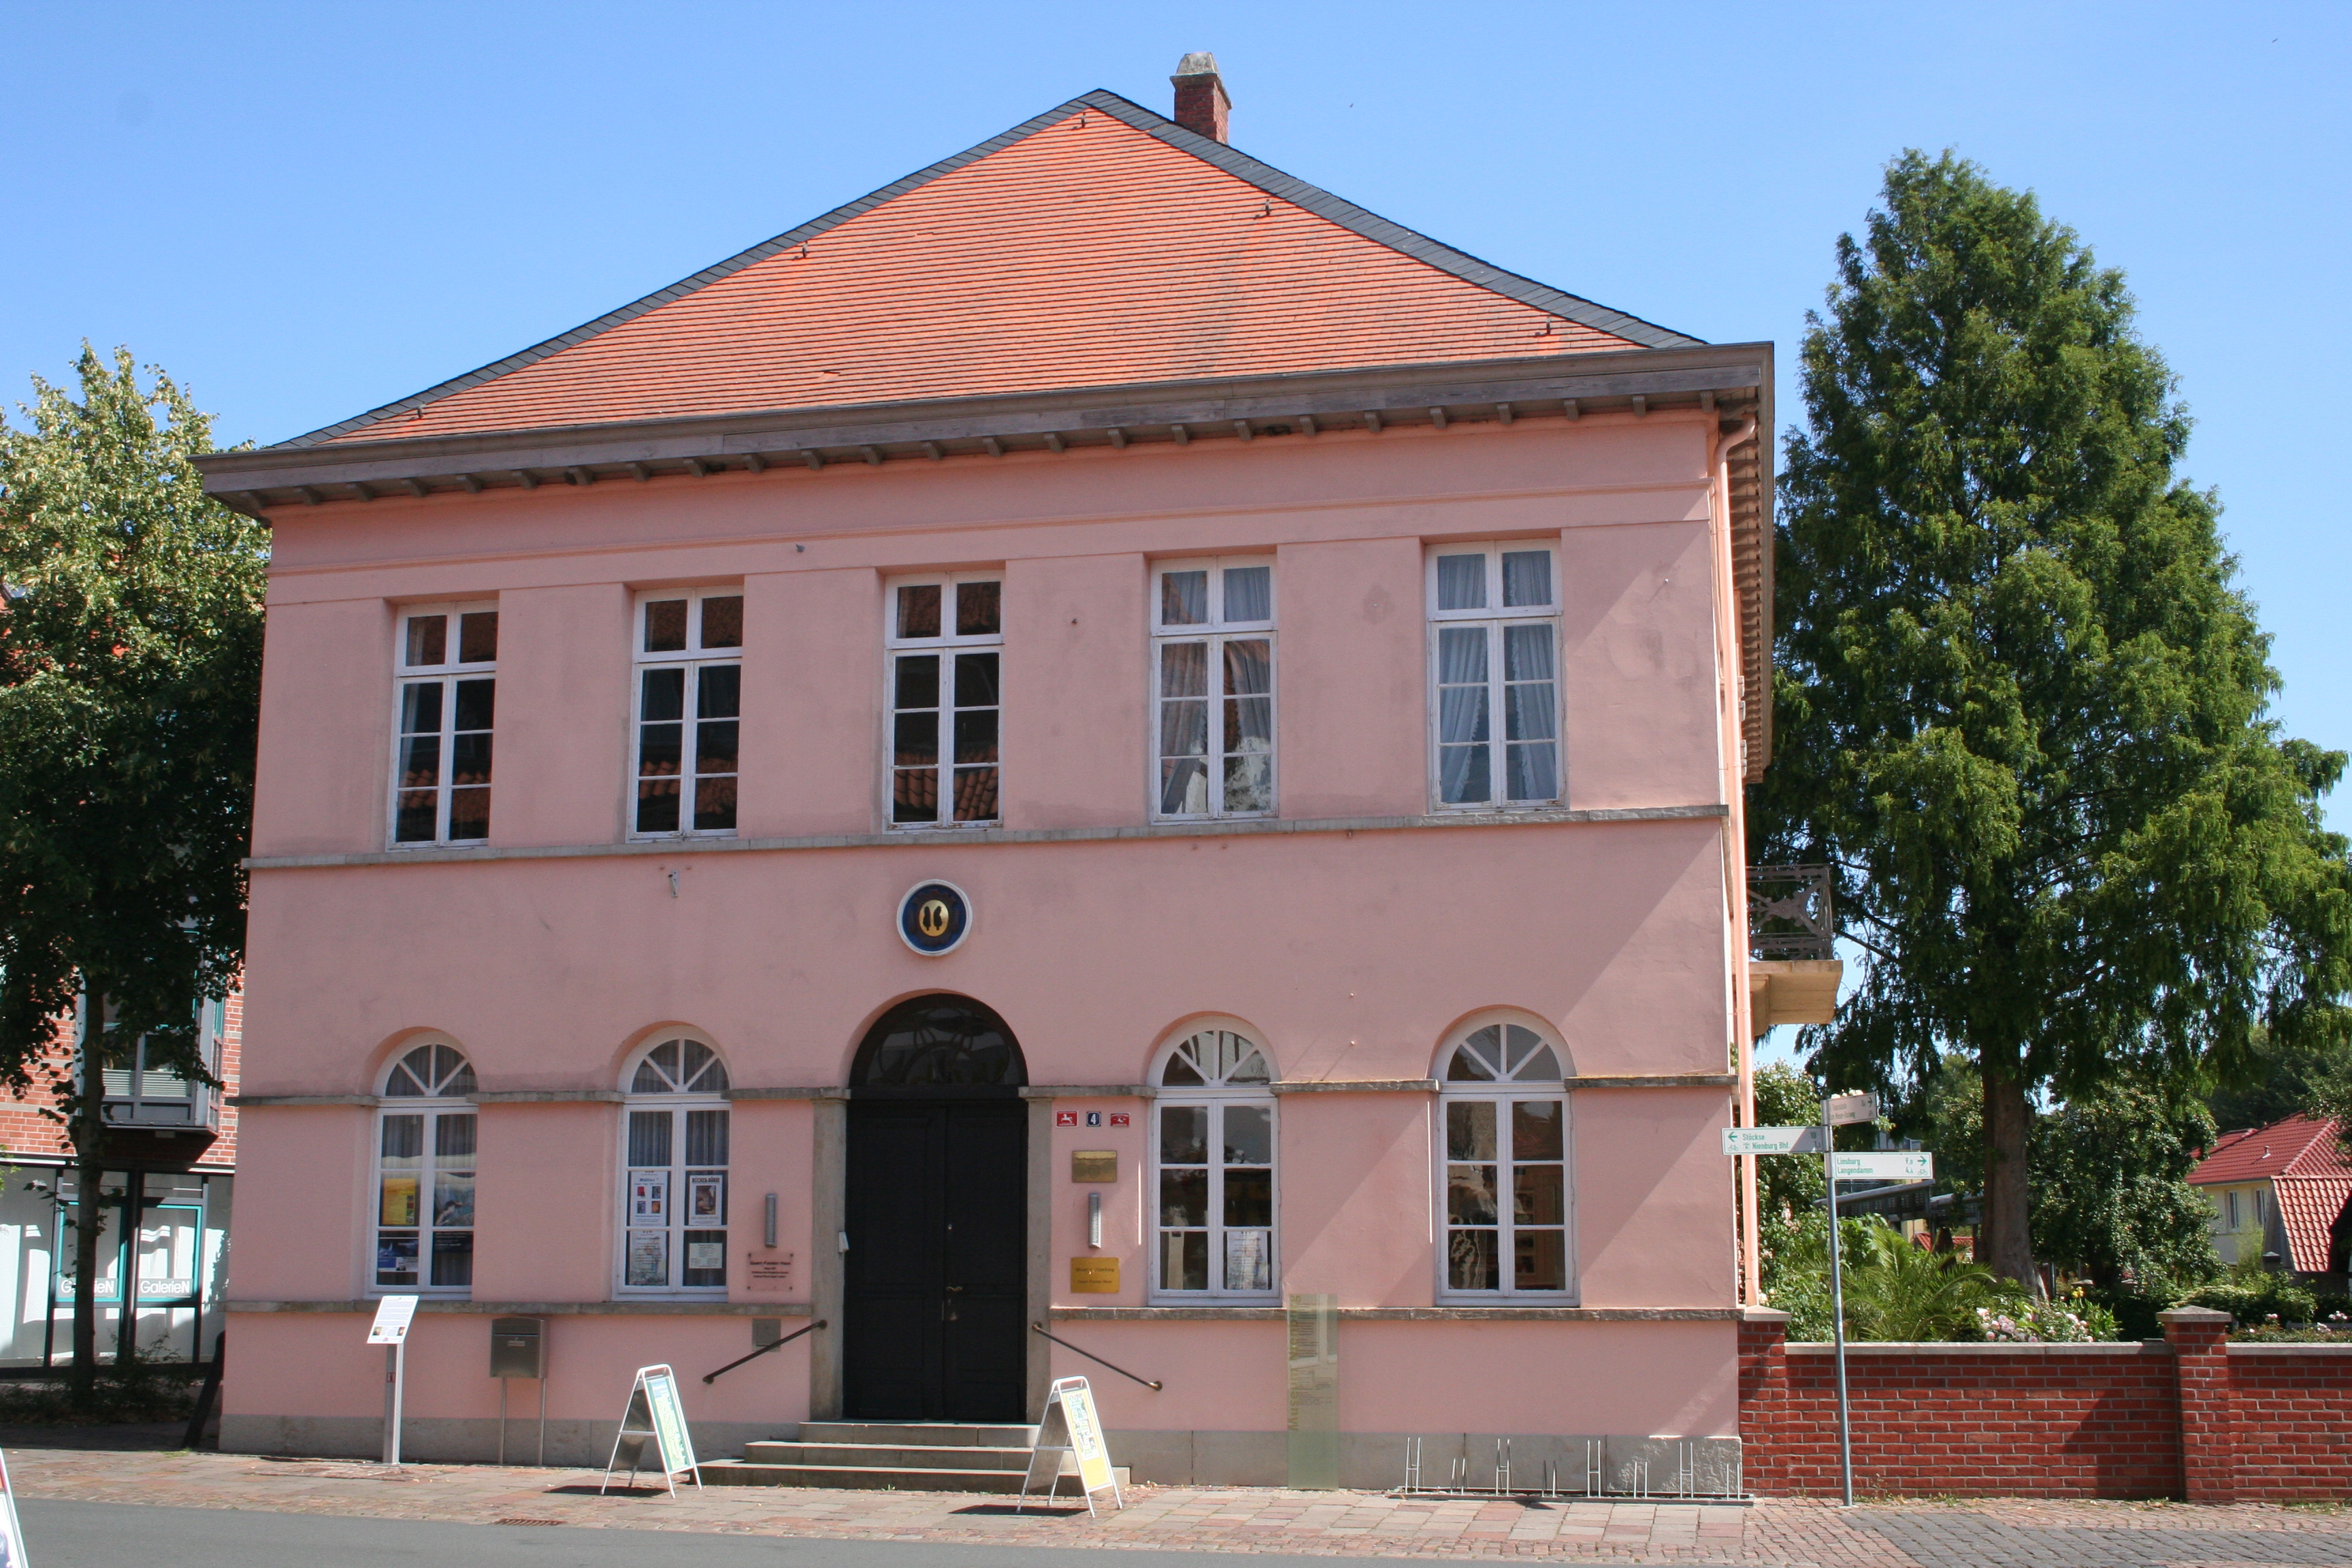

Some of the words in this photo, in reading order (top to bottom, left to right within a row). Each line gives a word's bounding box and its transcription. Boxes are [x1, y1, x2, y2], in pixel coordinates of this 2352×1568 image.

[1090, 1113, 1096, 1124] 4
[1837, 1158, 1861, 1166] Linsburg
[1838, 1166, 1874, 1175] Langendamm
[140, 1280, 190, 1293] GalerieN
[1288, 1368, 1298, 1431] Museum
